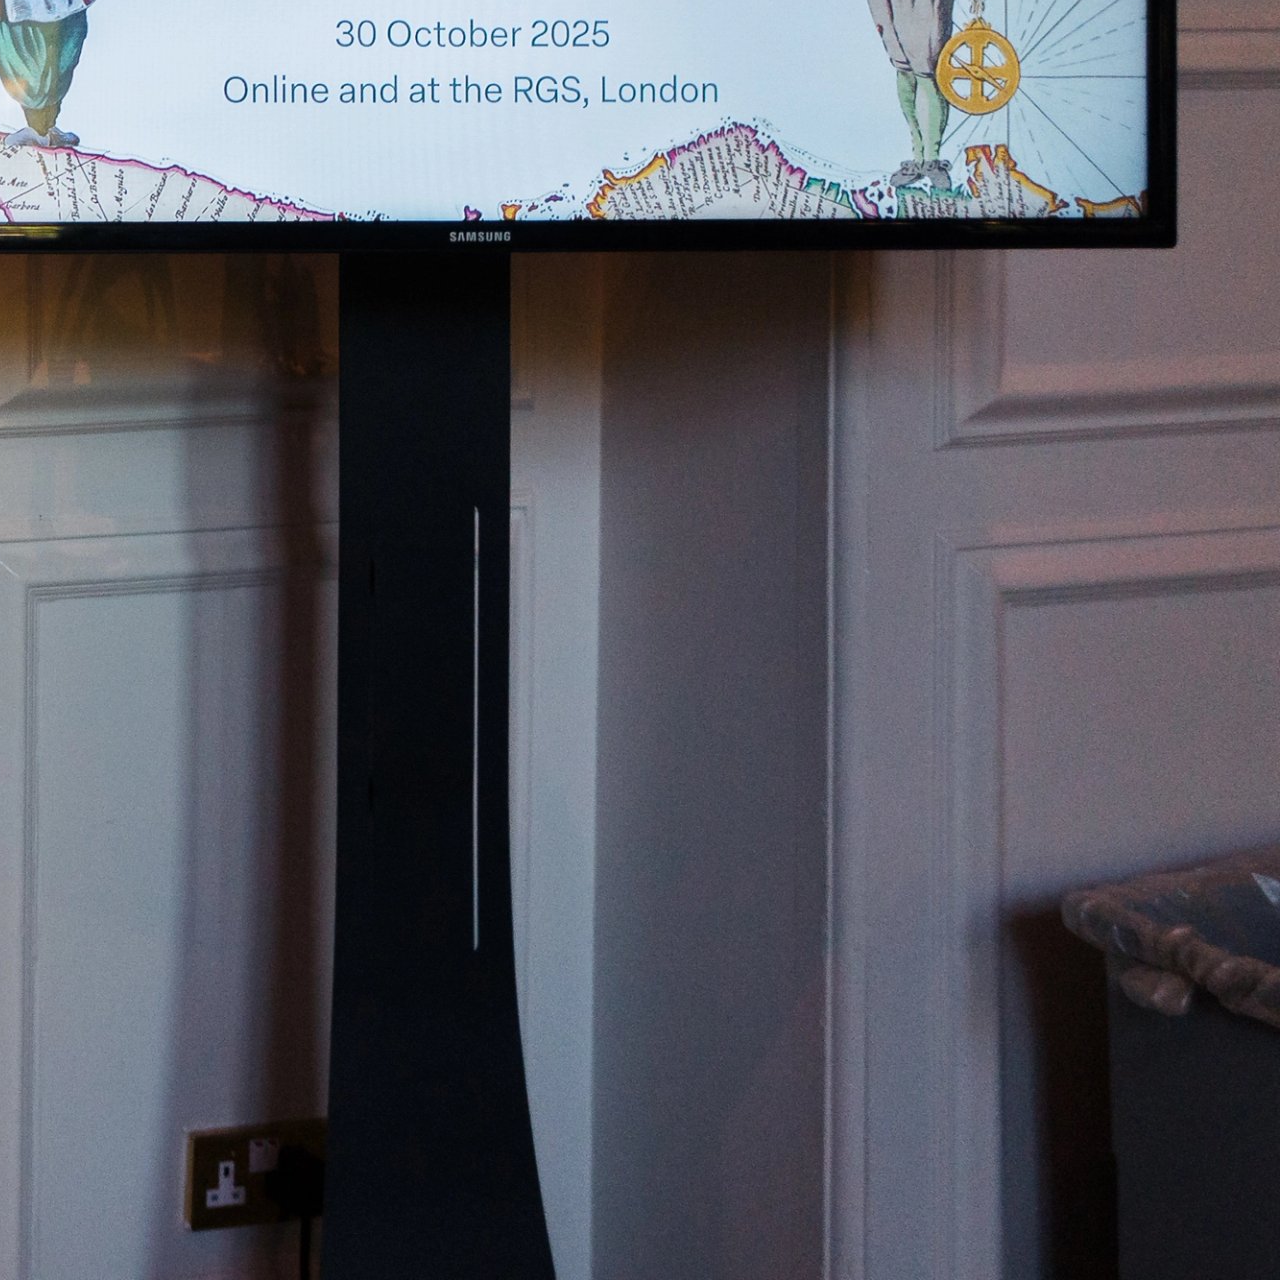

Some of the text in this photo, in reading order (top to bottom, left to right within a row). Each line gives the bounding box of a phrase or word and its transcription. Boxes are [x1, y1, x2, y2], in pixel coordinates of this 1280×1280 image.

[336, 19, 609, 47] 30 October 2025
[224, 74, 718, 108] Online and at the RGS, London
[449, 231, 511, 242] SAMSUNG
